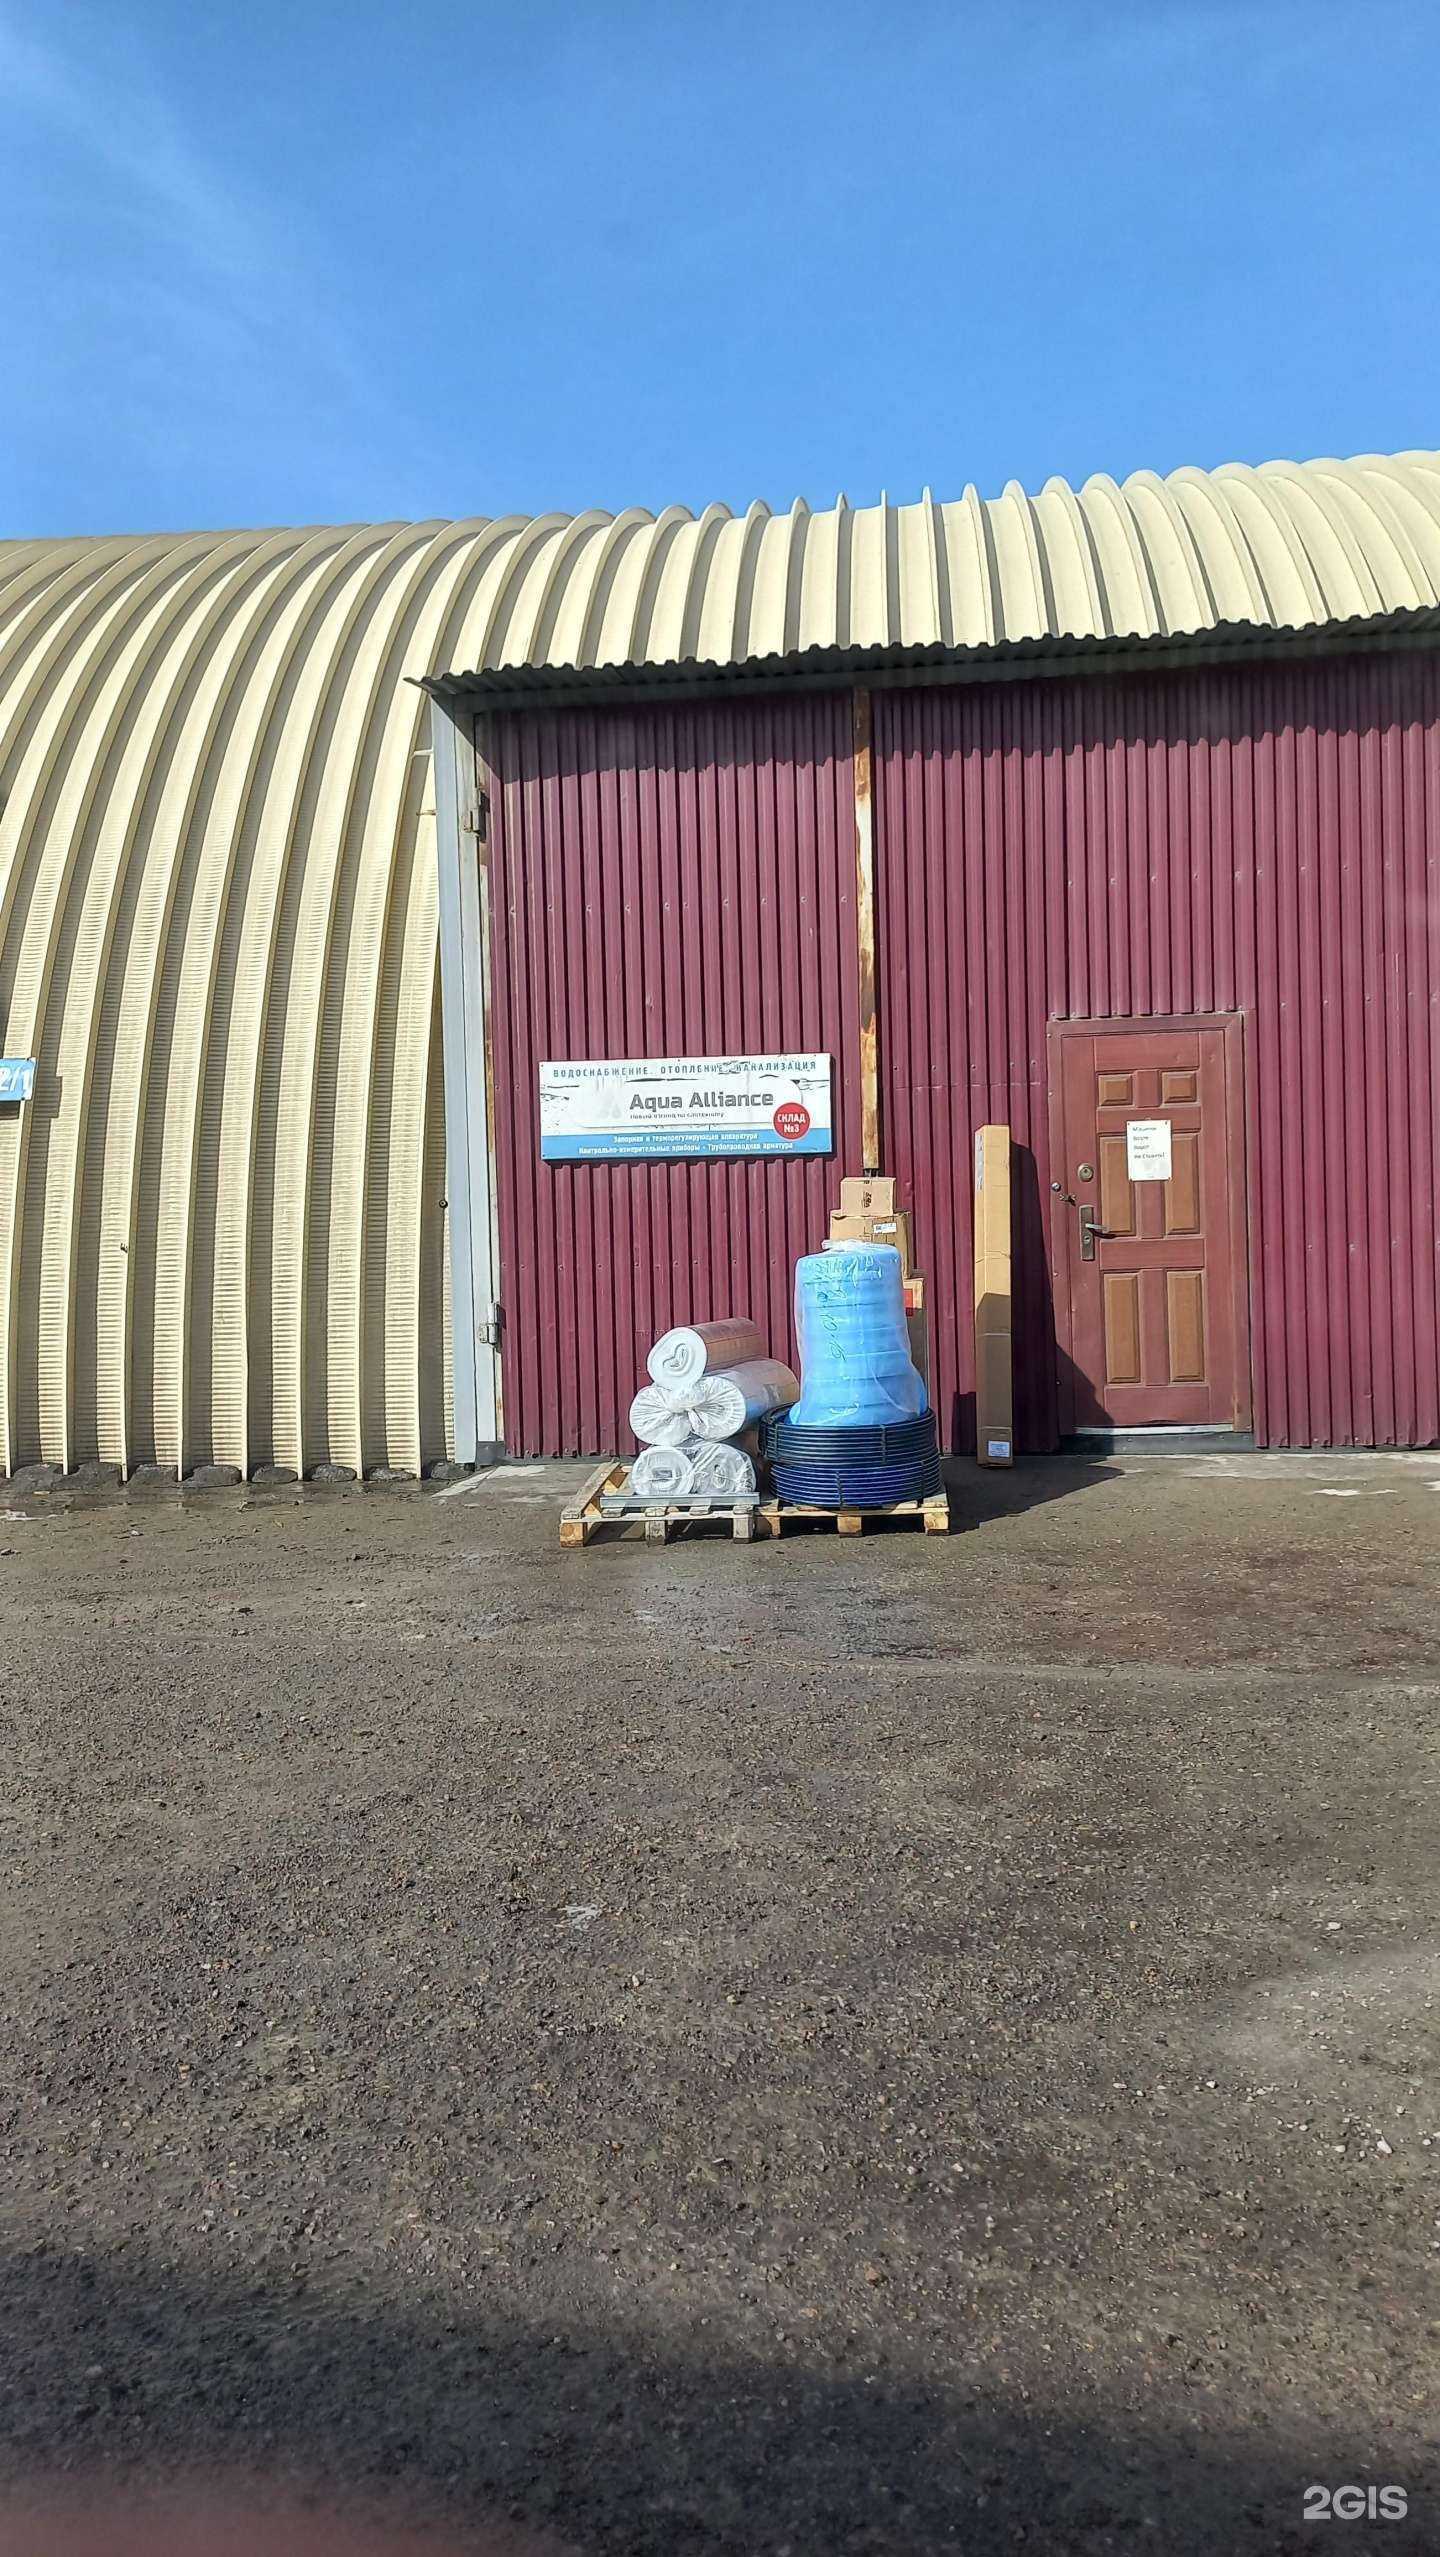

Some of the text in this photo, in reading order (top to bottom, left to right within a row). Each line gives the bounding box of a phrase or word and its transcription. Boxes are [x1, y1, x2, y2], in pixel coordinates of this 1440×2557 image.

[629, 1090, 775, 1113] Aqua Alliance
[777, 1112, 806, 1124] СКЛАД
[783, 1123, 800, 1134] №3
